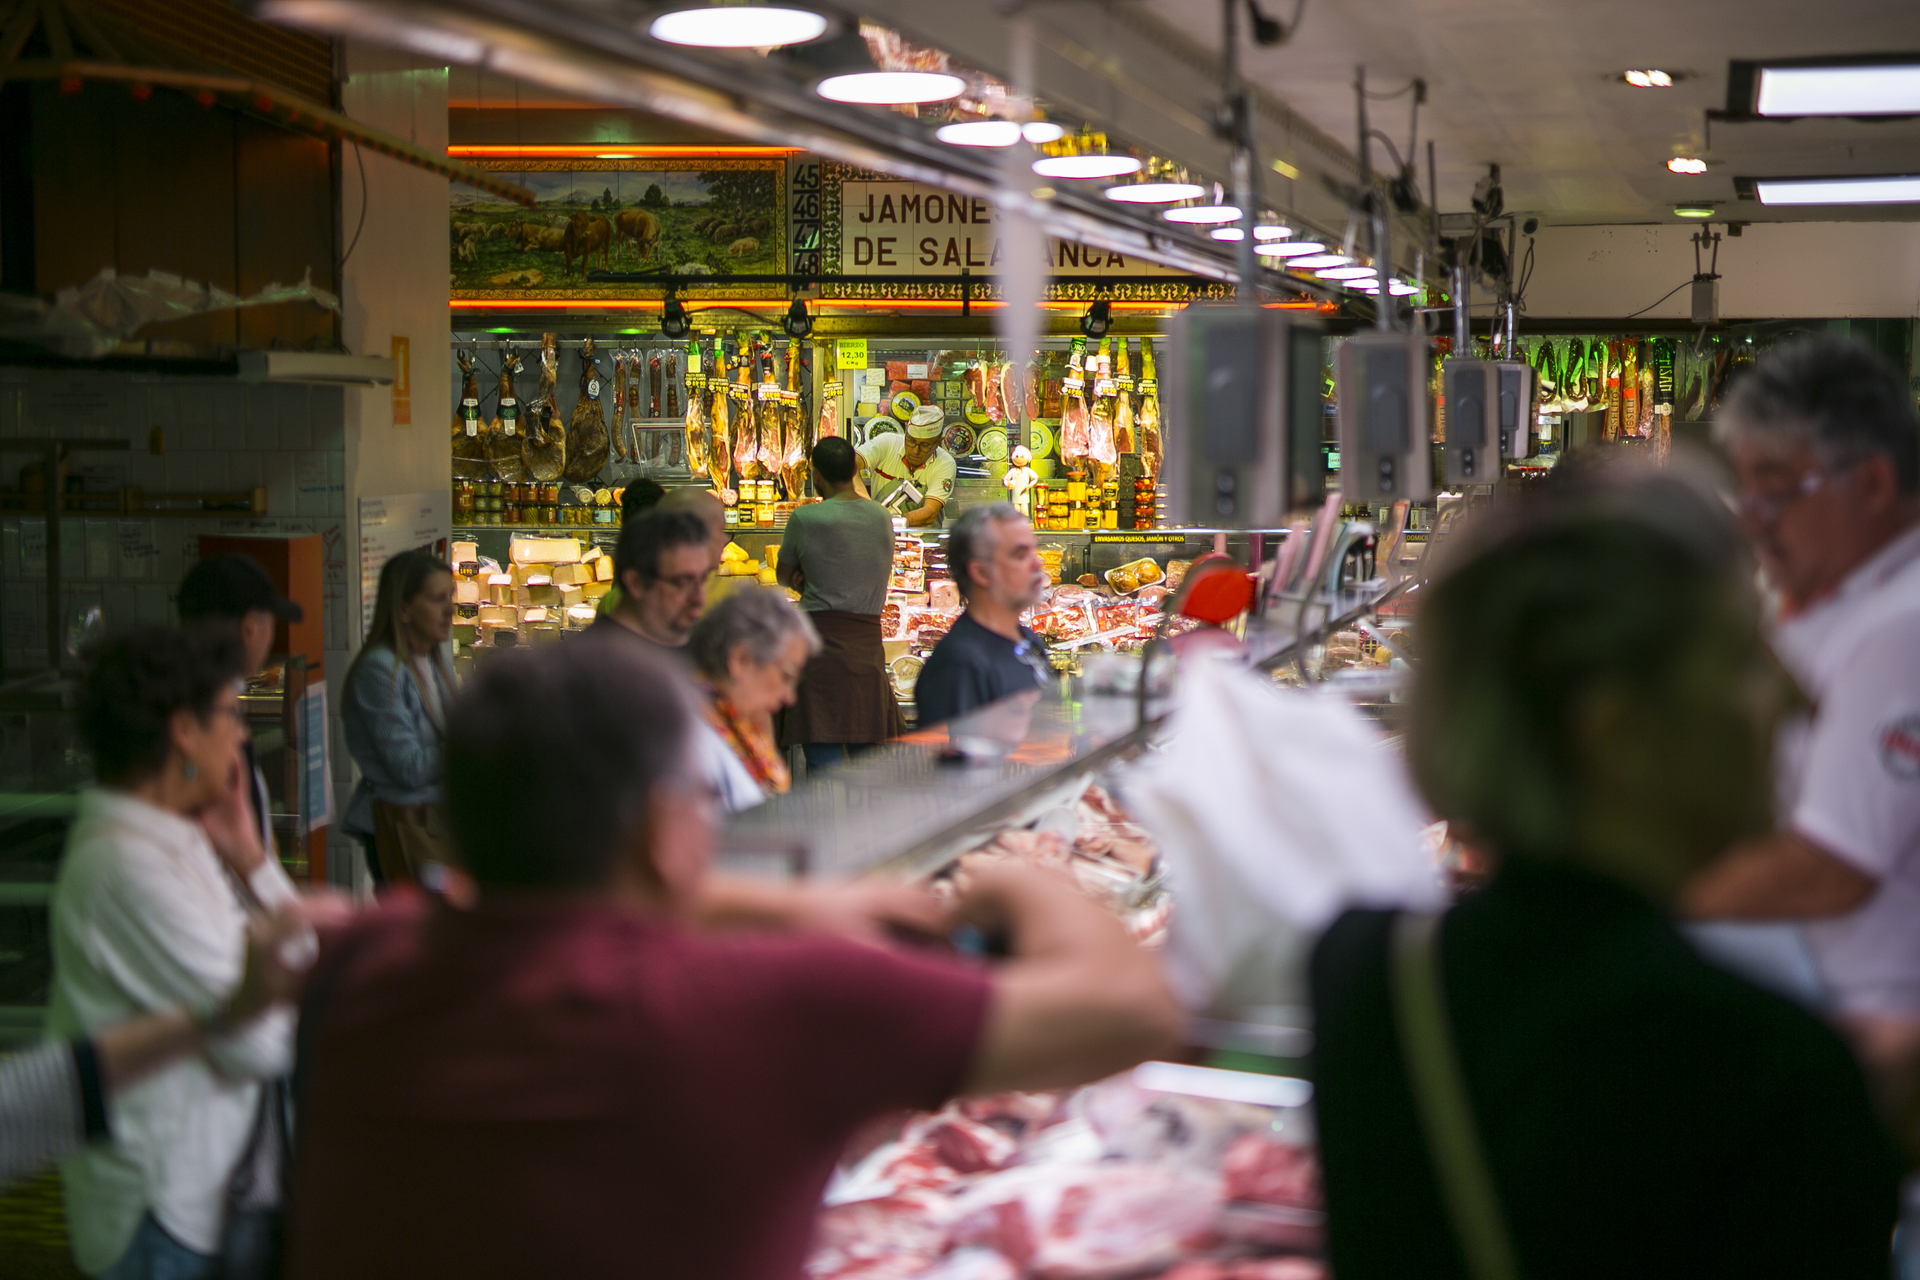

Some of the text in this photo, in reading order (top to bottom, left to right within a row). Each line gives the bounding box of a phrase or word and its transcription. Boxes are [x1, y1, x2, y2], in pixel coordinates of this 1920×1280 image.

[793, 164, 819, 189] 45
[793, 194, 819, 218] 46
[859, 194, 1002, 224] JAMONE
[794, 223, 819, 248] 47
[794, 252, 819, 275] 48
[854, 237, 1125, 268] DE SALAANCA
[841, 351, 865, 360] 12,30
[1611, 391, 1619, 435] JOSELITO
[1626, 400, 1635, 430] JOSELI
[1146, 534, 1164, 542] JAMÓN
